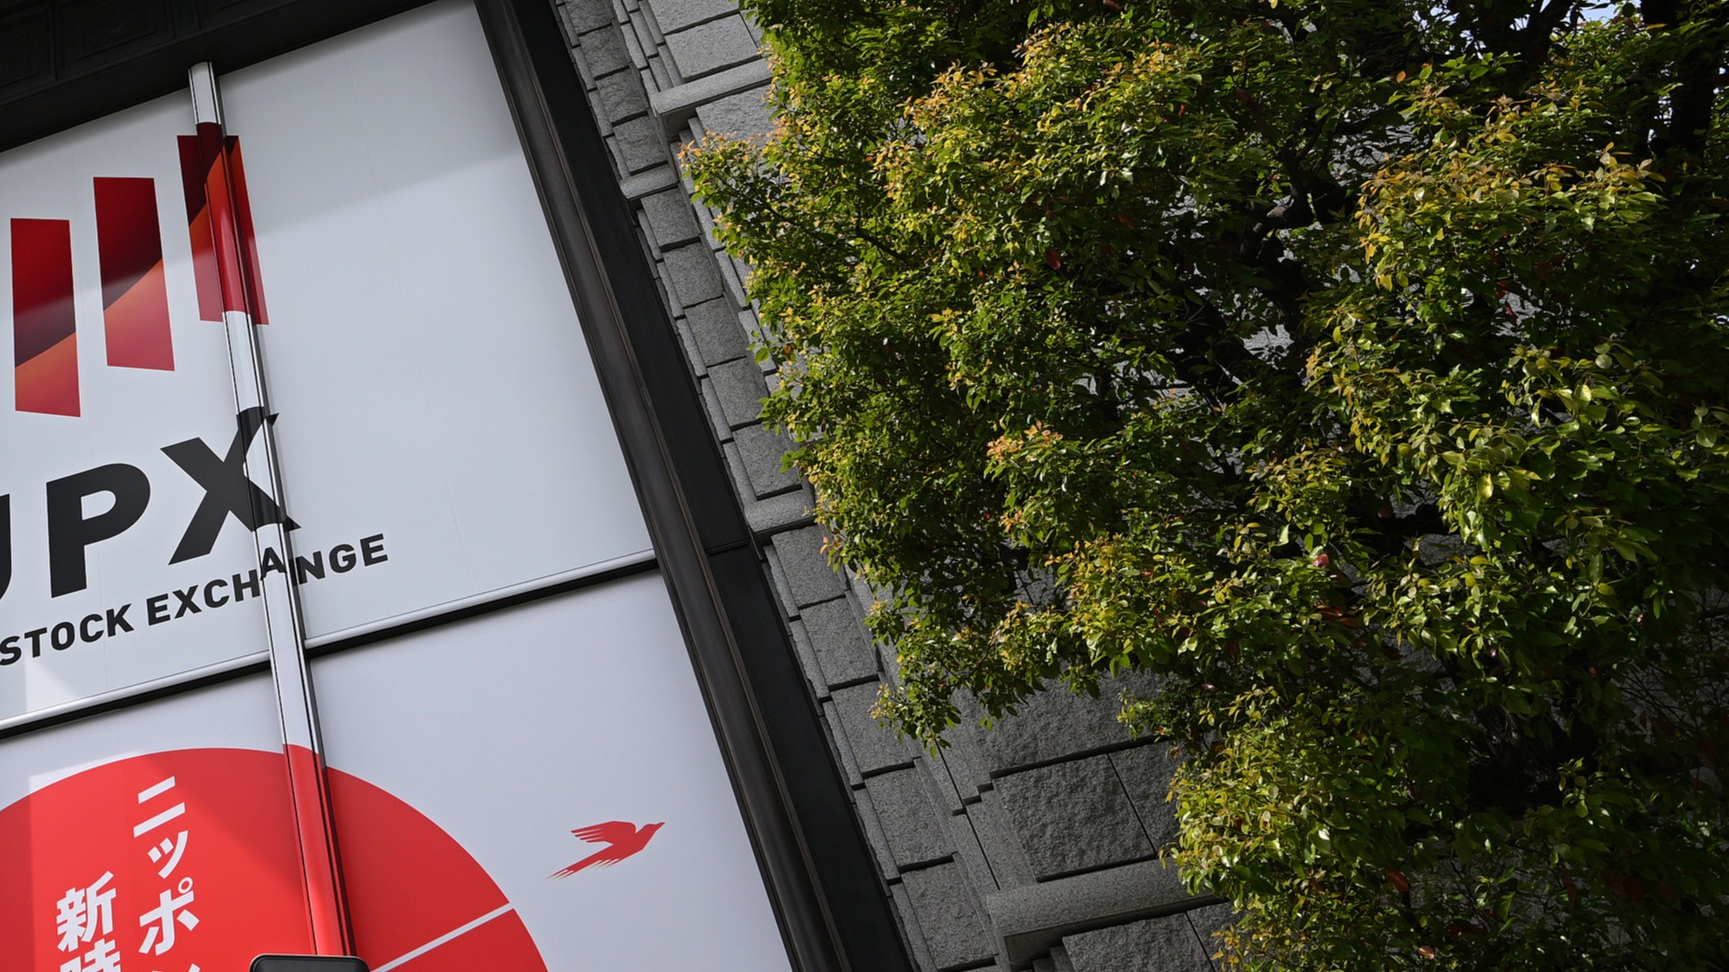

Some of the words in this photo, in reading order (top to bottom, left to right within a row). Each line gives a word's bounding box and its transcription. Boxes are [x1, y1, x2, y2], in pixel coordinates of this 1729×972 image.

[145, 533, 389, 626] EXCHANGE
[133, 775, 201, 972] ニッポ
